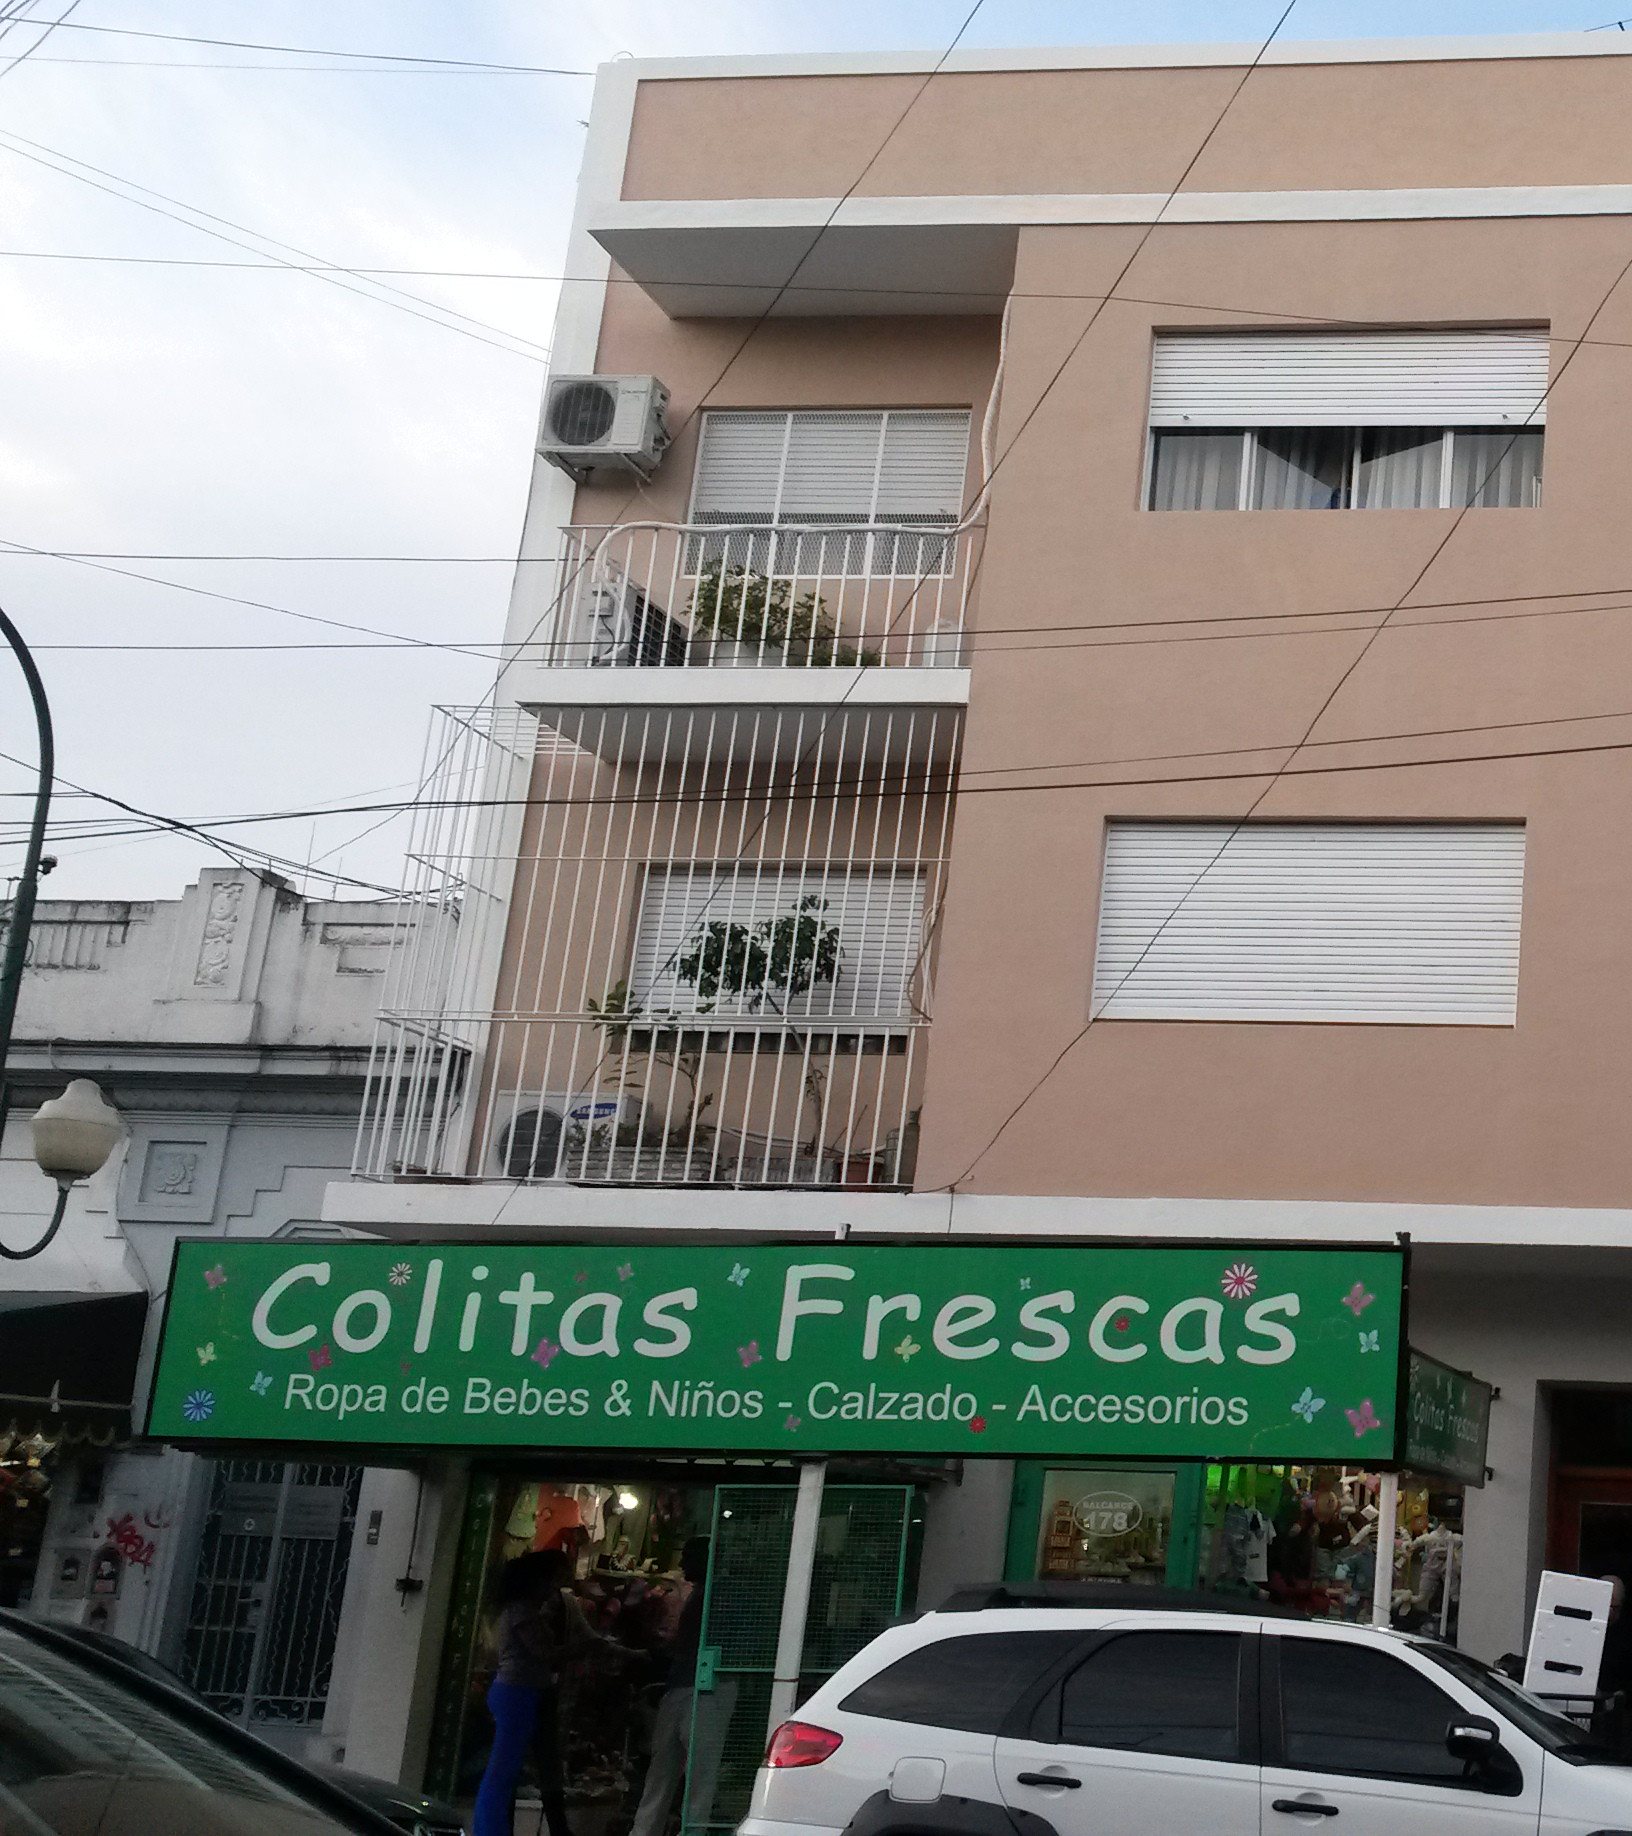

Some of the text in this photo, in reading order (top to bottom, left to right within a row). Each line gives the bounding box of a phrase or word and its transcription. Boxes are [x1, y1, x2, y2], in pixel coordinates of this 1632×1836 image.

[251, 1257, 1301, 1366] Colitas Frescas
[284, 1373, 388, 1421] Ropa
[401, 1377, 450, 1414] de
[463, 1377, 590, 1416] Bebes
[604, 1379, 632, 1417] &
[648, 1380, 763, 1418] Niños
[807, 1381, 978, 1421] Calzado
[1016, 1384, 1249, 1426] Accesorios
[1087, 1510, 1128, 1532] 178
